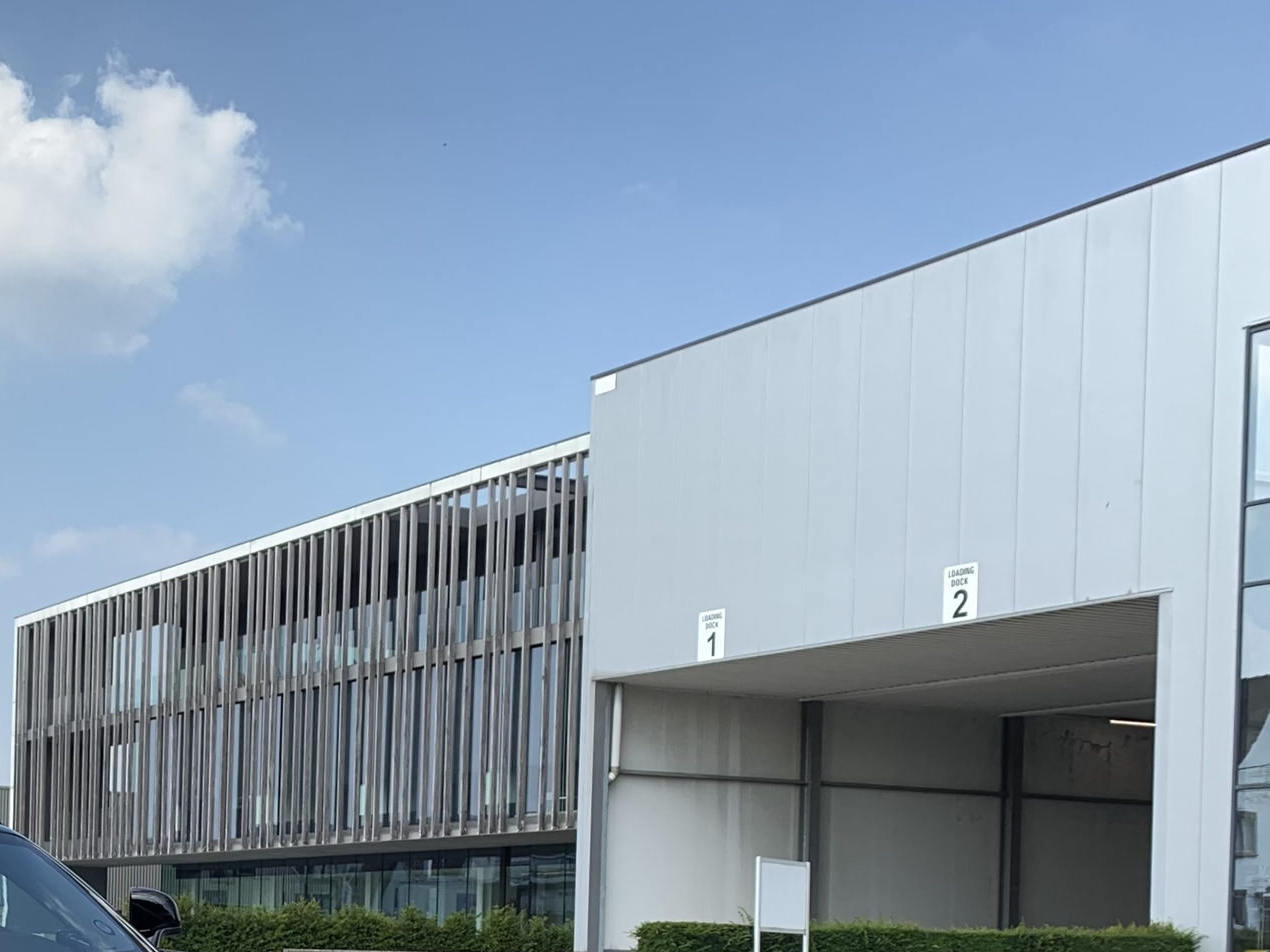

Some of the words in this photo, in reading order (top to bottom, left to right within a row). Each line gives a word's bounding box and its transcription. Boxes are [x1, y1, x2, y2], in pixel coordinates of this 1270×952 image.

[948, 566, 975, 578] LOADING
[951, 577, 969, 587] DOCK
[952, 589, 968, 619] 2
[702, 612, 723, 622] LOADING
[705, 621, 719, 630] DOCK
[707, 631, 716, 657] 1
